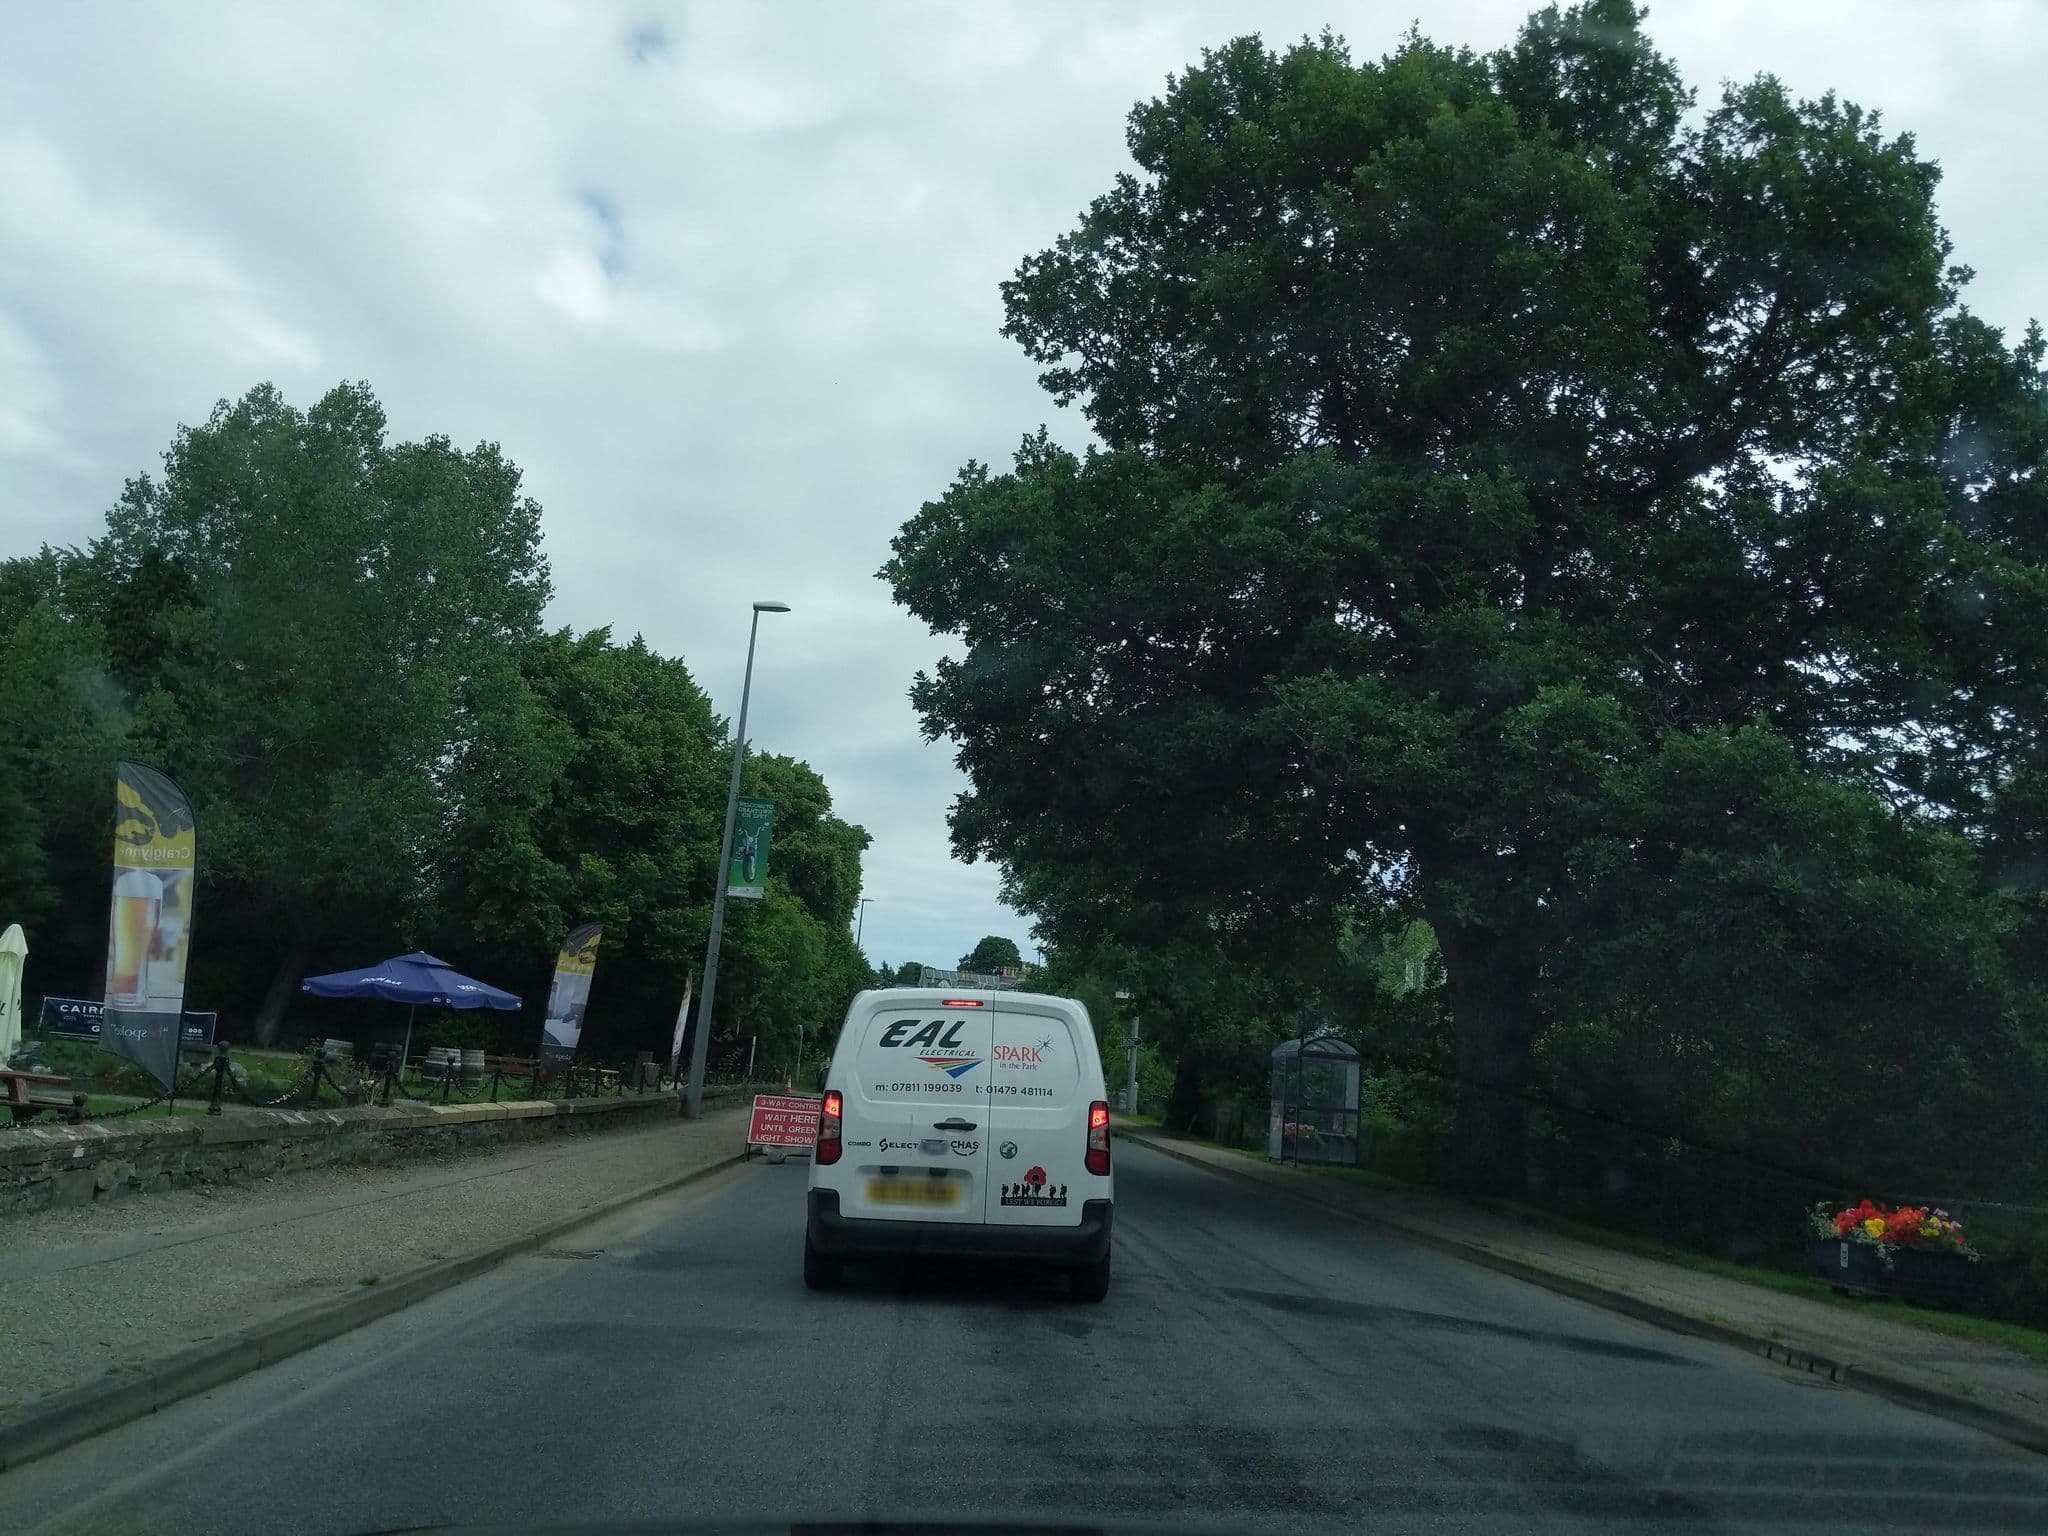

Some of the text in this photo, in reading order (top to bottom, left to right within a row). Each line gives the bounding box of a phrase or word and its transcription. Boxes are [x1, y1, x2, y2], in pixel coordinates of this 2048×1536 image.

[879, 1019, 966, 1049] EAL
[919, 1049, 976, 1057] ELECTRICAL
[993, 1046, 1043, 1063] SPARK
[1000, 1062, 1038, 1072] in the Park
[875, 1083, 962, 1093] m: 07811 199039
[975, 1085, 1053, 1097] t: 01479 481114
[764, 1113, 817, 1124] WAIT HERE
[760, 1123, 785, 1132] UNTIL
[755, 1133, 781, 1142] LIGHT
[879, 1138, 919, 1152] SELECT
[950, 1140, 980, 1150] CHAS
